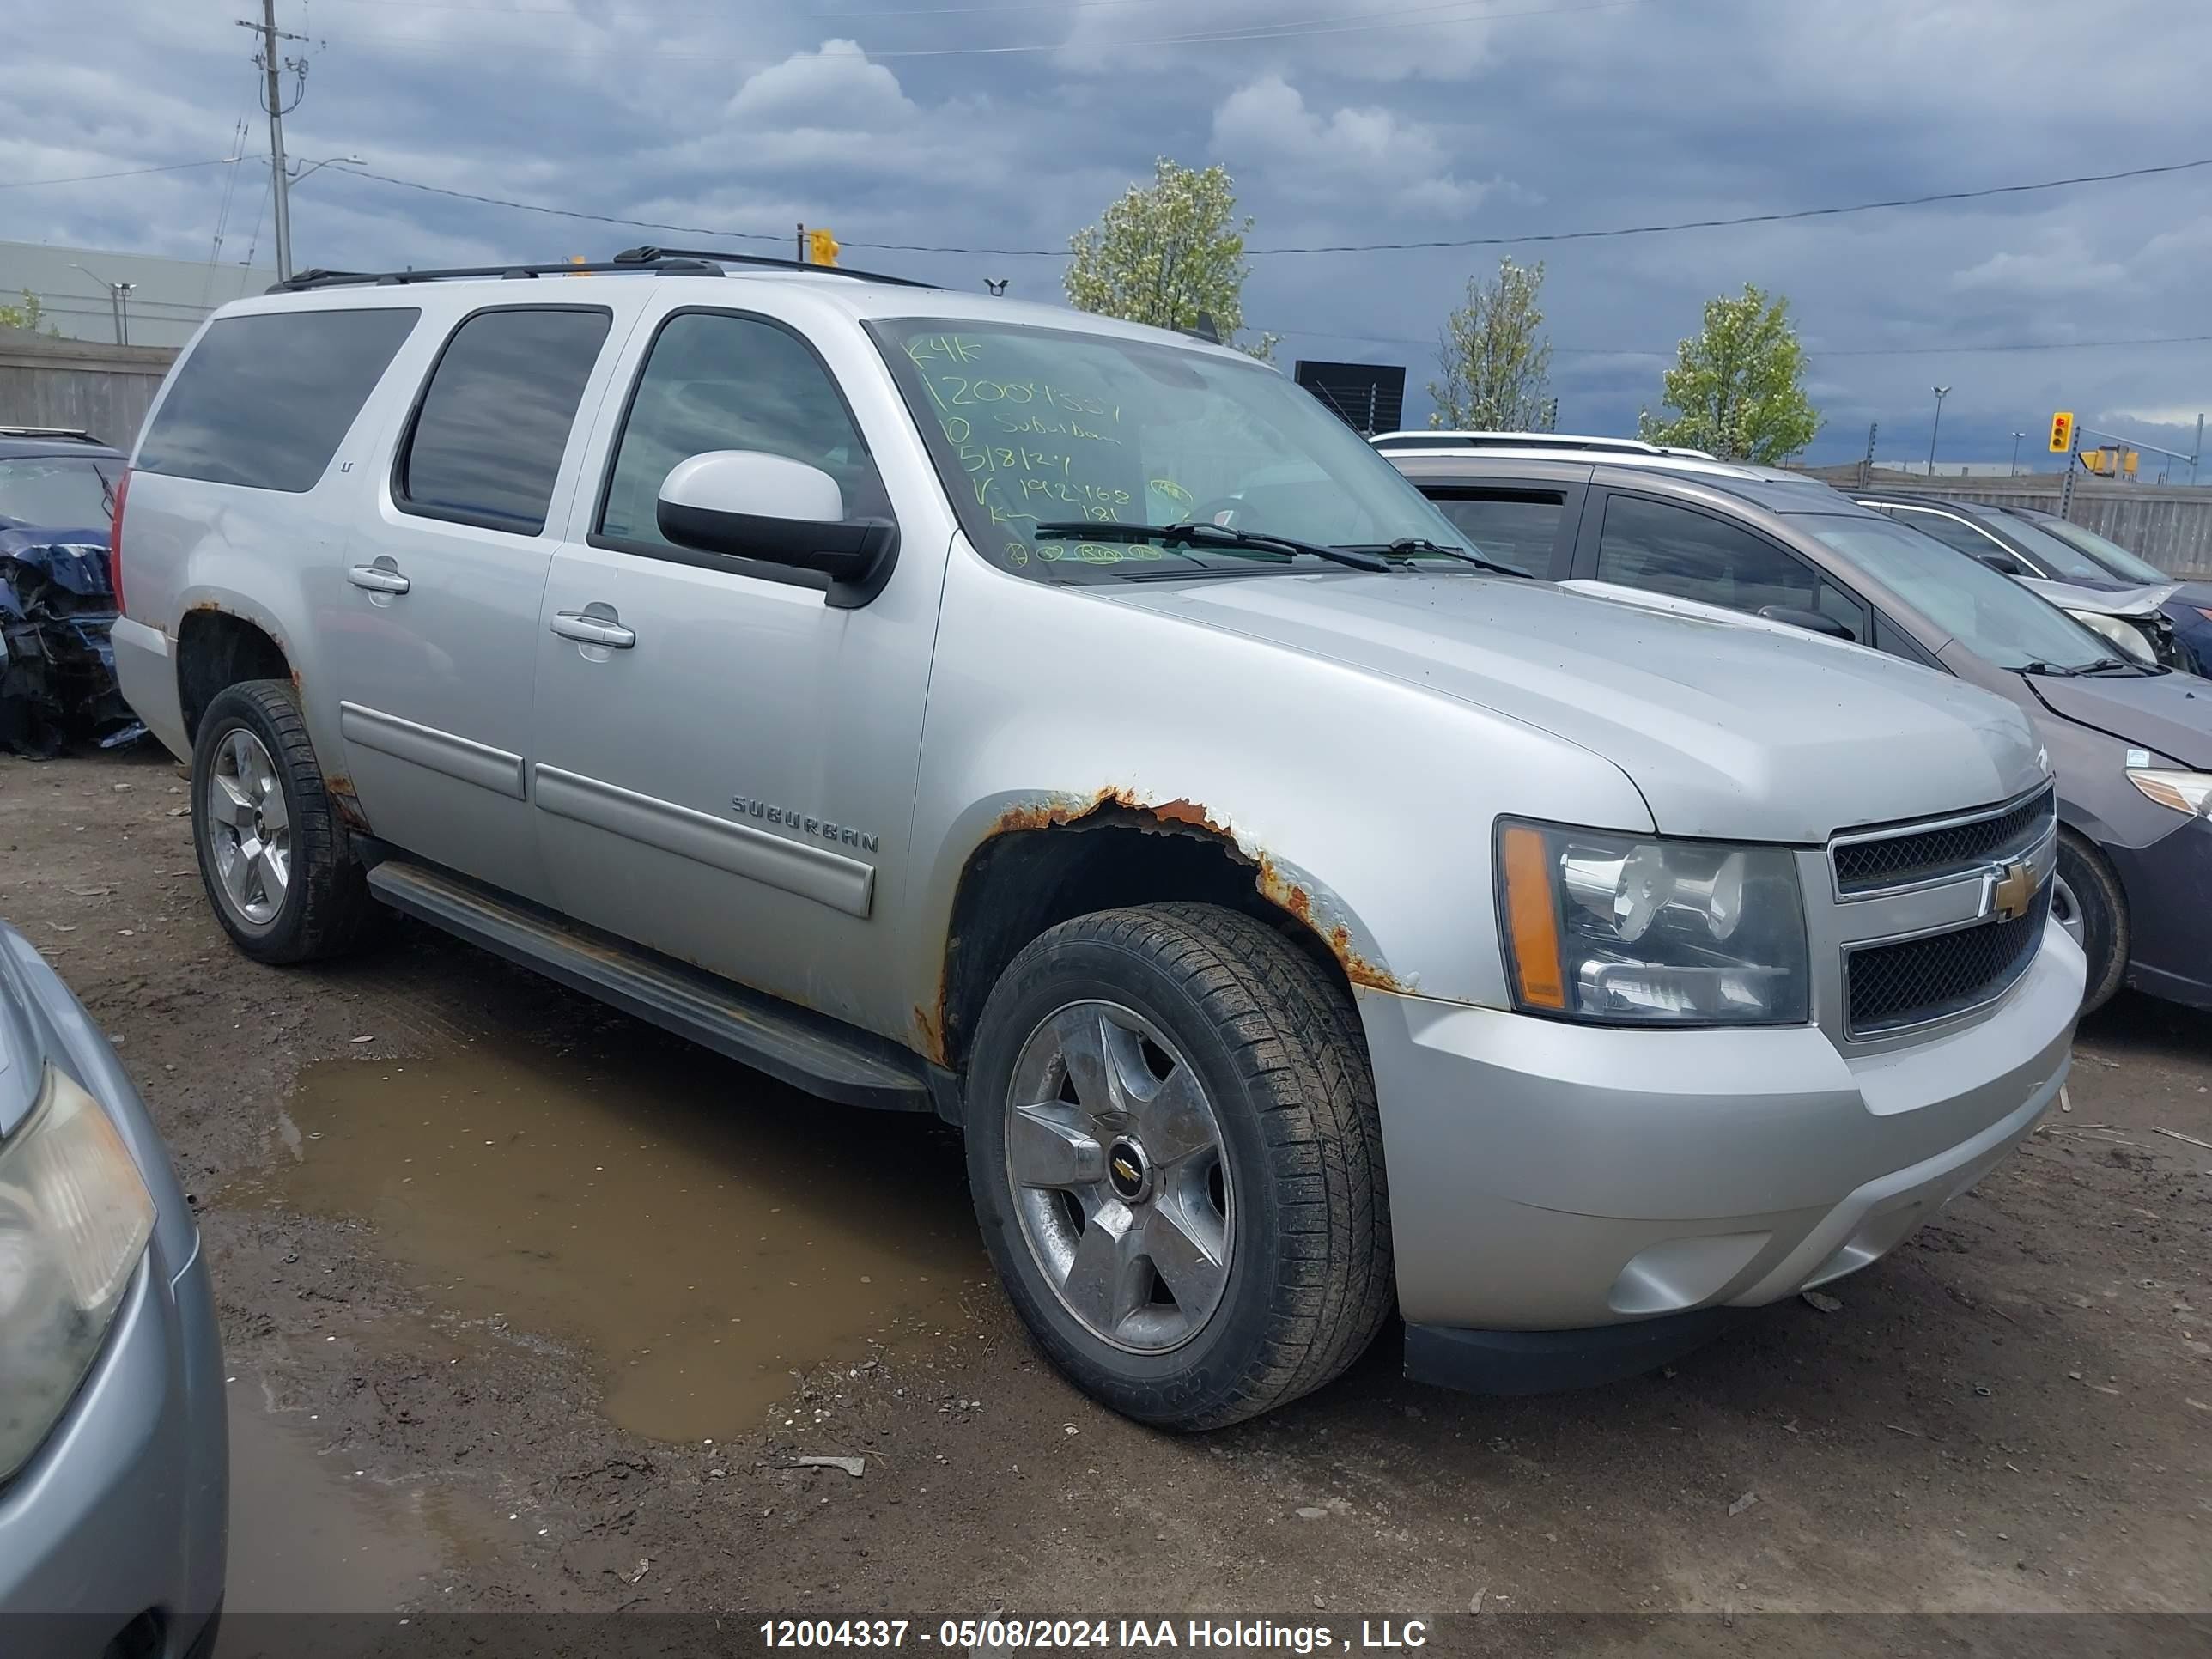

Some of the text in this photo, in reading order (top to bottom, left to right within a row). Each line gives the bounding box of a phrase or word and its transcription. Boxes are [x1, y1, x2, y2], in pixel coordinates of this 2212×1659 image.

[939, 416, 969, 446] 10
[340, 461, 355, 473] LT
[732, 795, 879, 853] SUBURBAN
